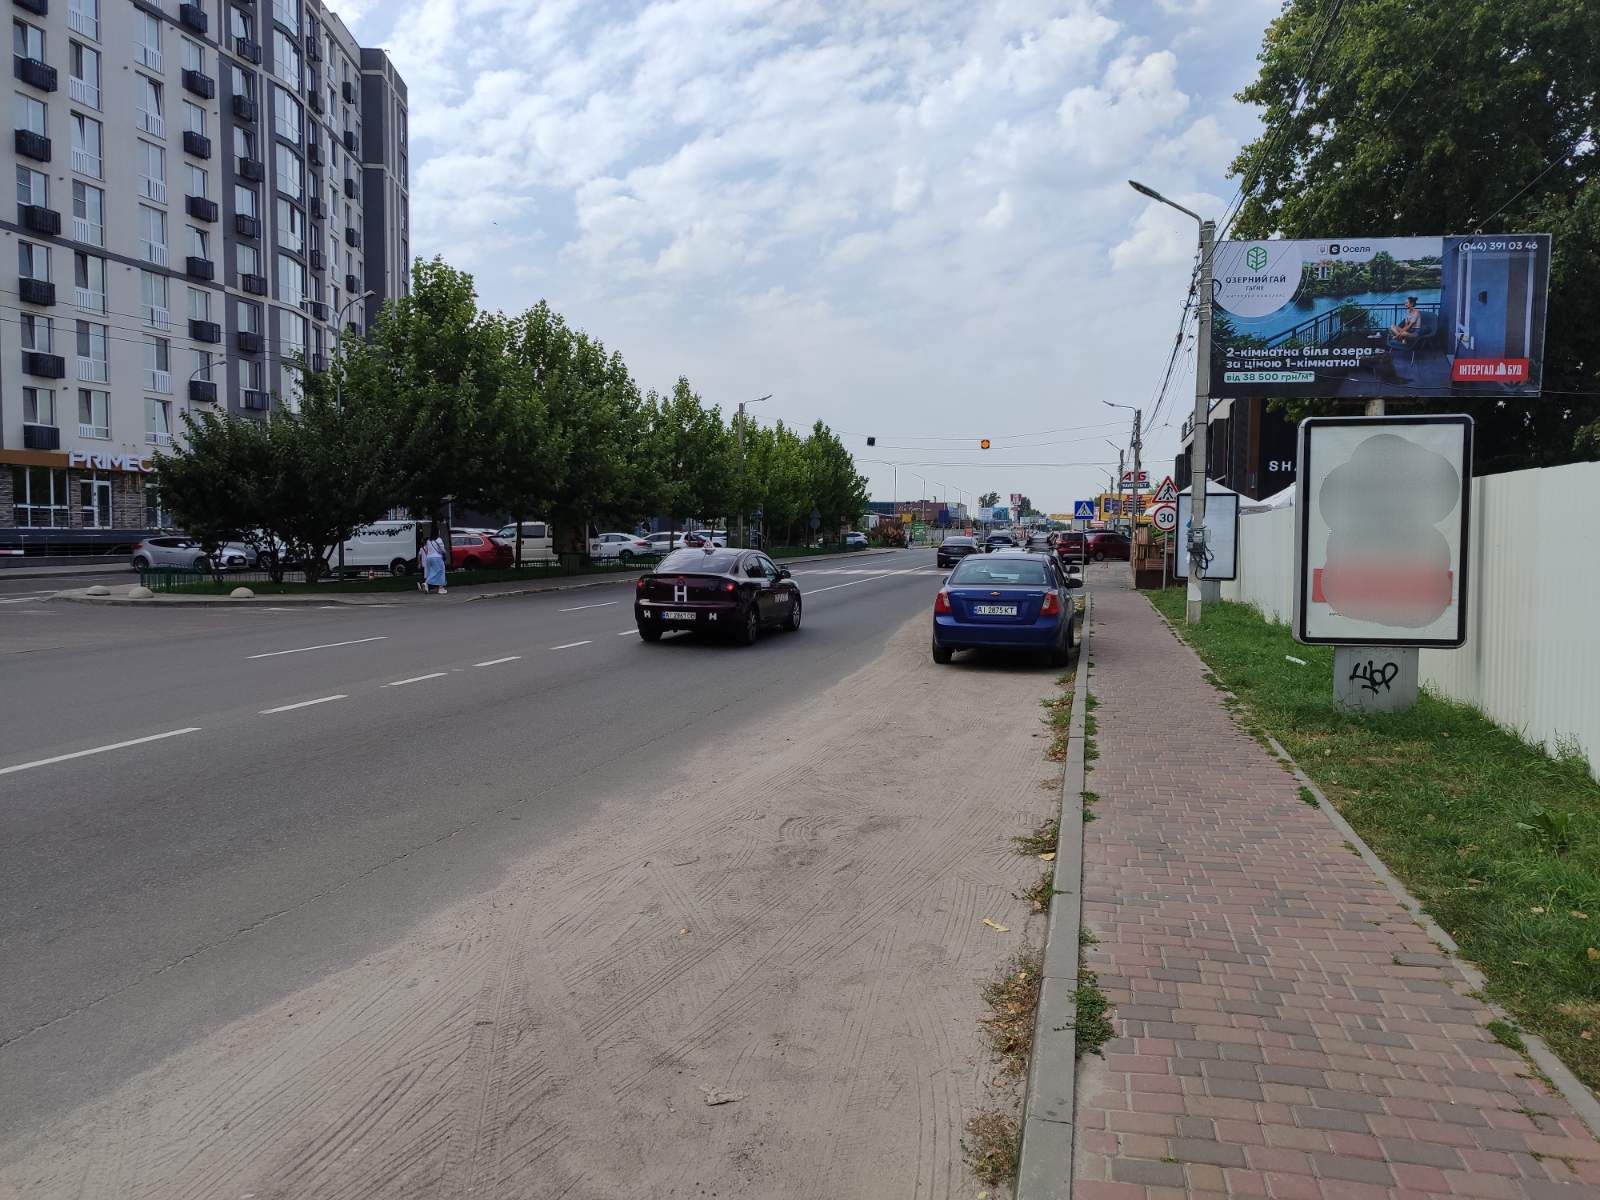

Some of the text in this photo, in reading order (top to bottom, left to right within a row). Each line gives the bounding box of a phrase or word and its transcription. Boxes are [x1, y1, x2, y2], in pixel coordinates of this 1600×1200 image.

[1342, 245, 1371, 253] Оселя
[1459, 241, 1538, 251] (044) 391 03 46
[1225, 274, 1286, 284] ОЗЕРНИЙ ГАЙ
[1226, 346, 1372, 358] 2-кімнатна біля озера
[1226, 358, 1360, 369] за ціною 1-кімнатної
[1459, 364, 1522, 375] ІНТЕРГАЛ БУД
[1226, 373, 1241, 382] від
[1243, 373, 1256, 381] 38
[1258, 373, 1279, 381] 500
[1269, 460, 1297, 472] SH
[1159, 513, 1174, 523] 30
